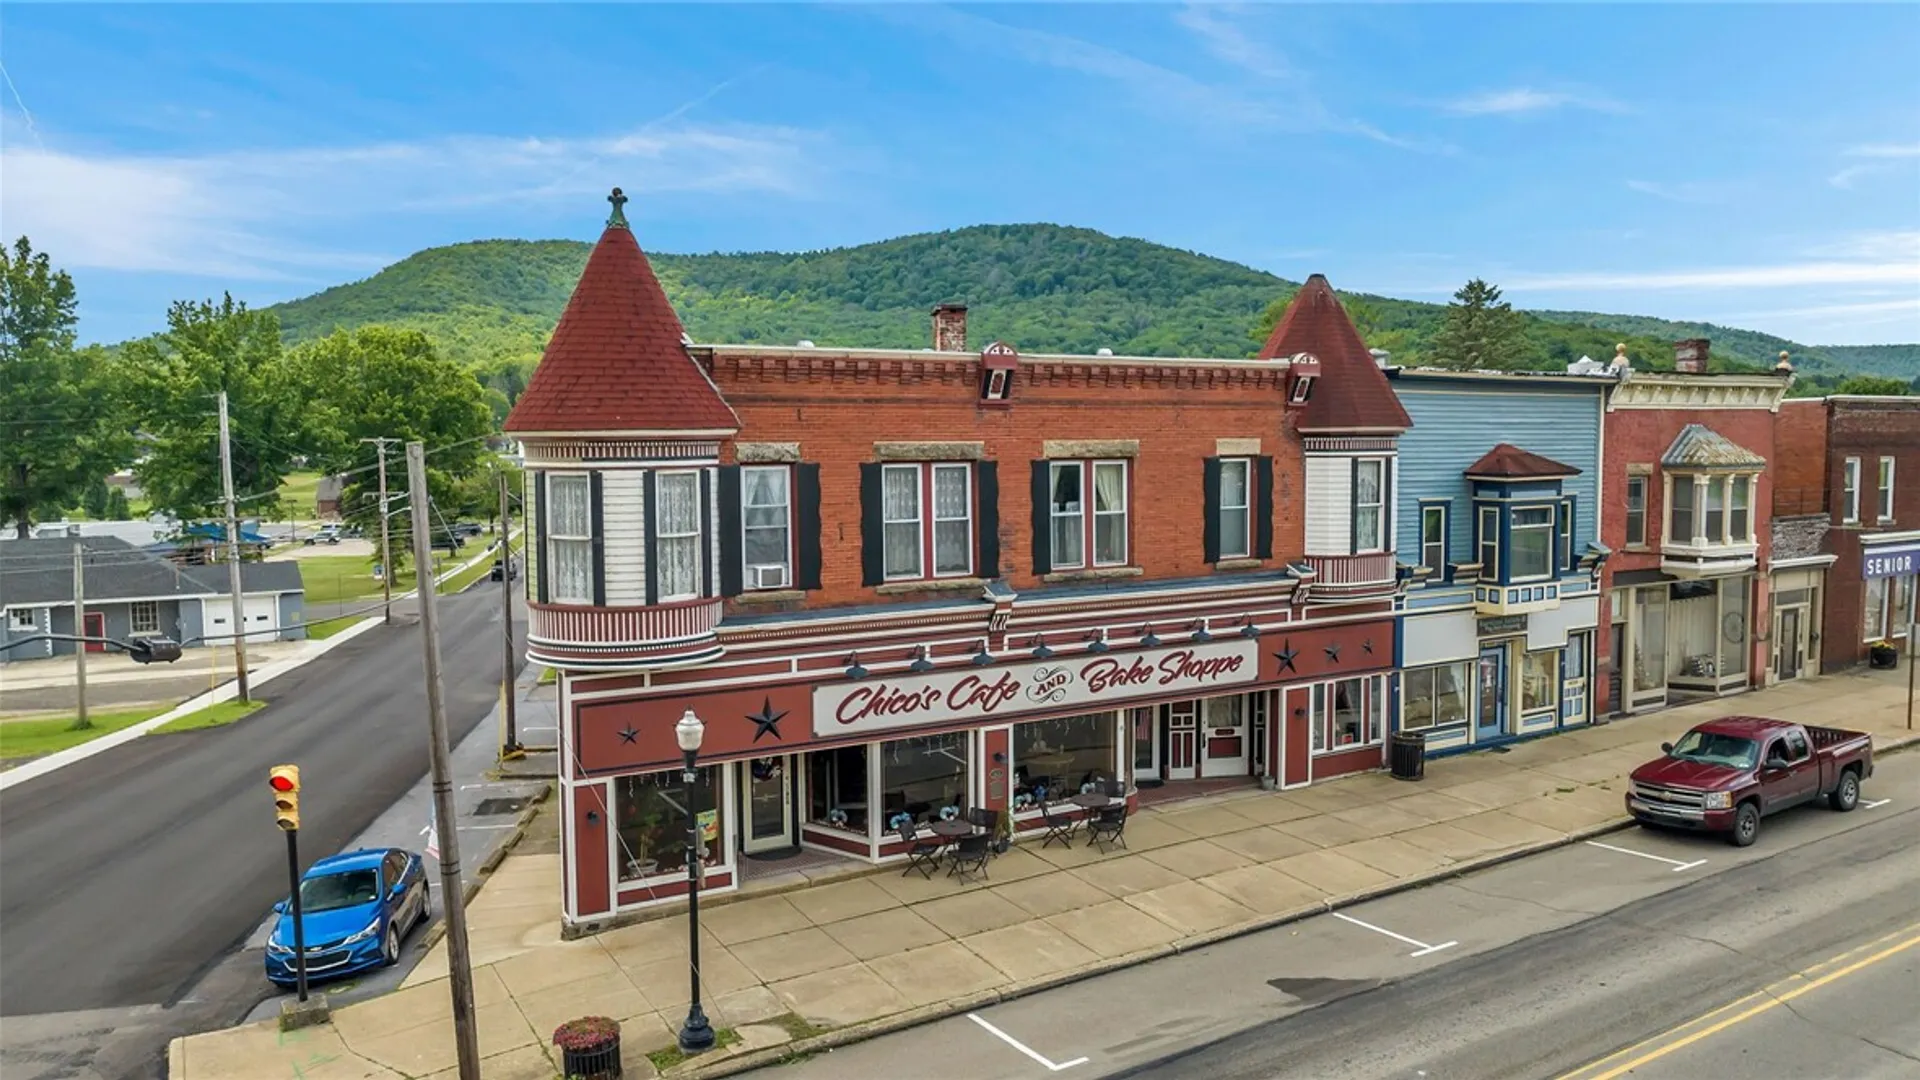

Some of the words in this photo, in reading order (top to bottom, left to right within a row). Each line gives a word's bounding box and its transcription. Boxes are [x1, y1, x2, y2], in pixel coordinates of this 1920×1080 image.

[1867, 555, 1911, 575] SENIOR
[836, 683, 941, 724] Chico's
[947, 670, 1021, 712] Cafe
[1035, 673, 1067, 695] AND
[1080, 655, 1154, 693] Bake
[1158, 650, 1244, 682] Shoppe
